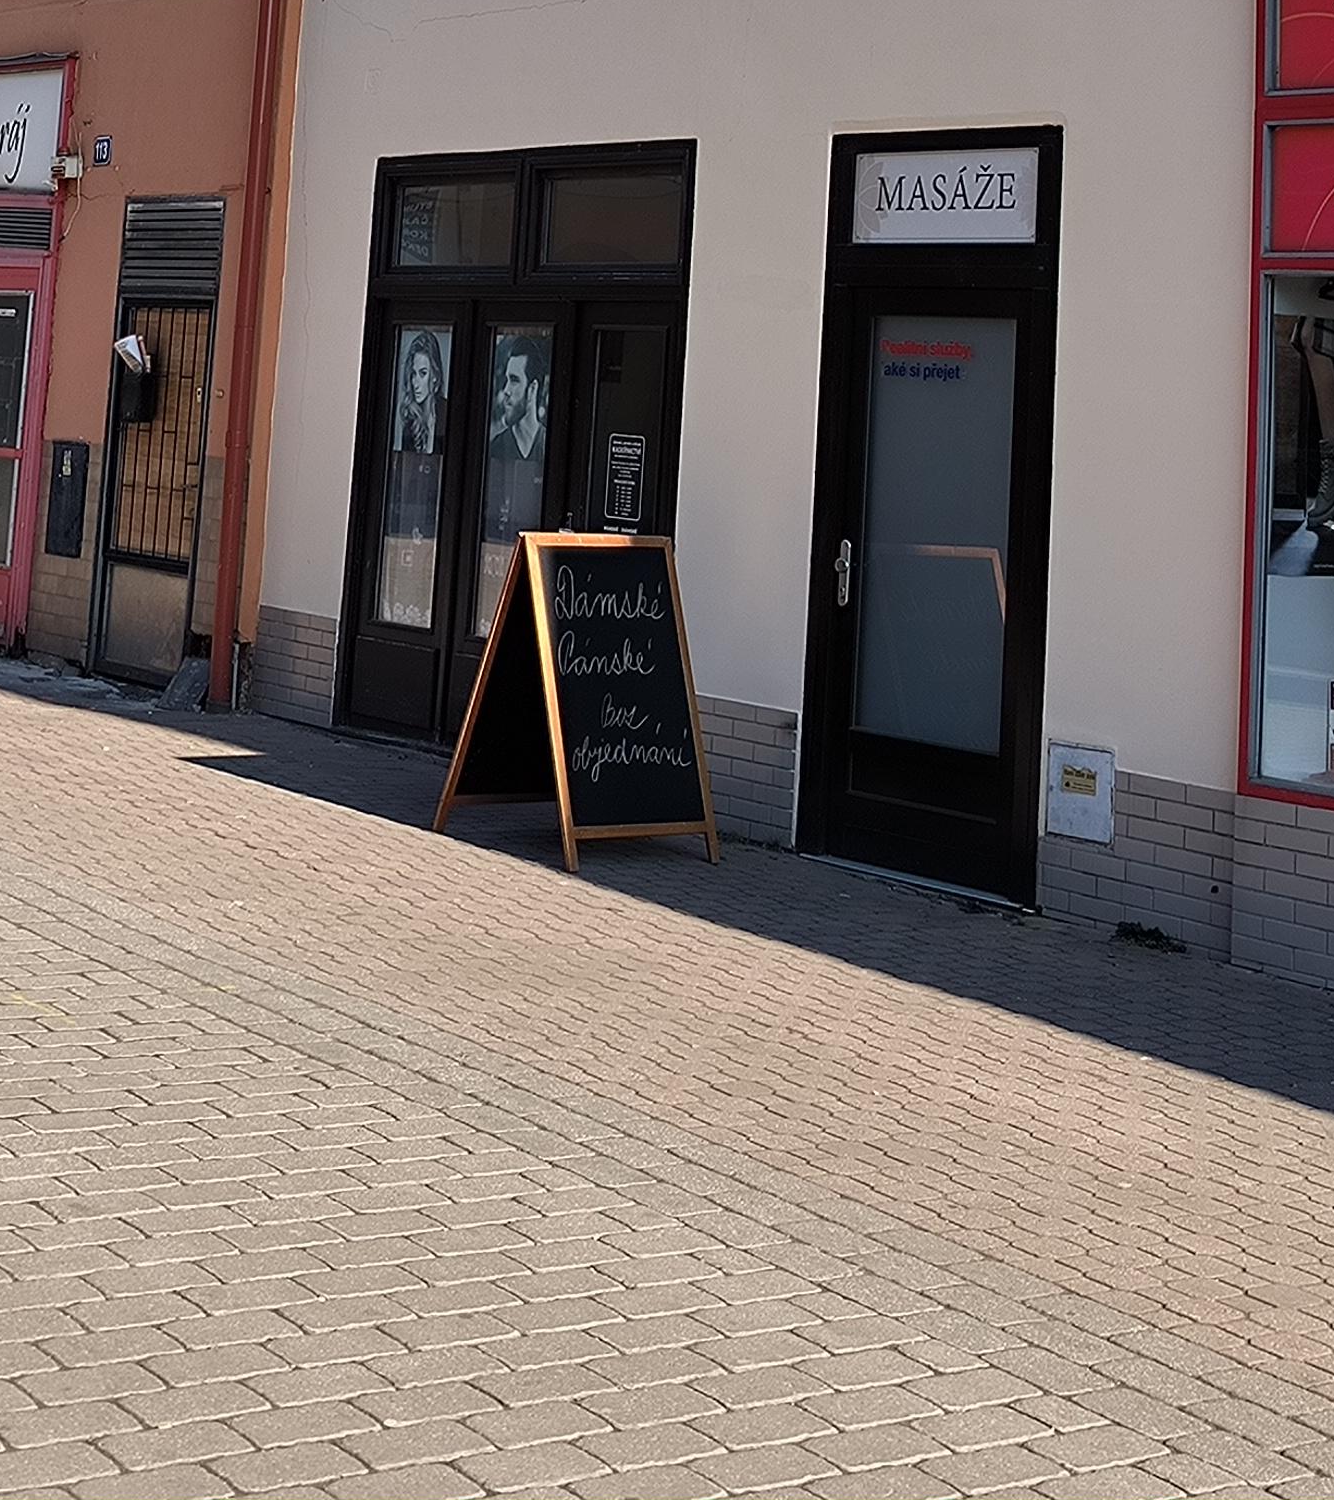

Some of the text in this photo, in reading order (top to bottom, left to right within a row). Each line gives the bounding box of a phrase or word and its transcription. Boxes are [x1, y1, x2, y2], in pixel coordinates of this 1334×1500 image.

[95, 141, 109, 160] 113
[875, 164, 1017, 211] MASÁŽE
[883, 361, 963, 382] aké si přejet
[554, 564, 666, 620] Dámské
[558, 630, 656, 676] Pánské
[571, 722, 692, 783] objednání
